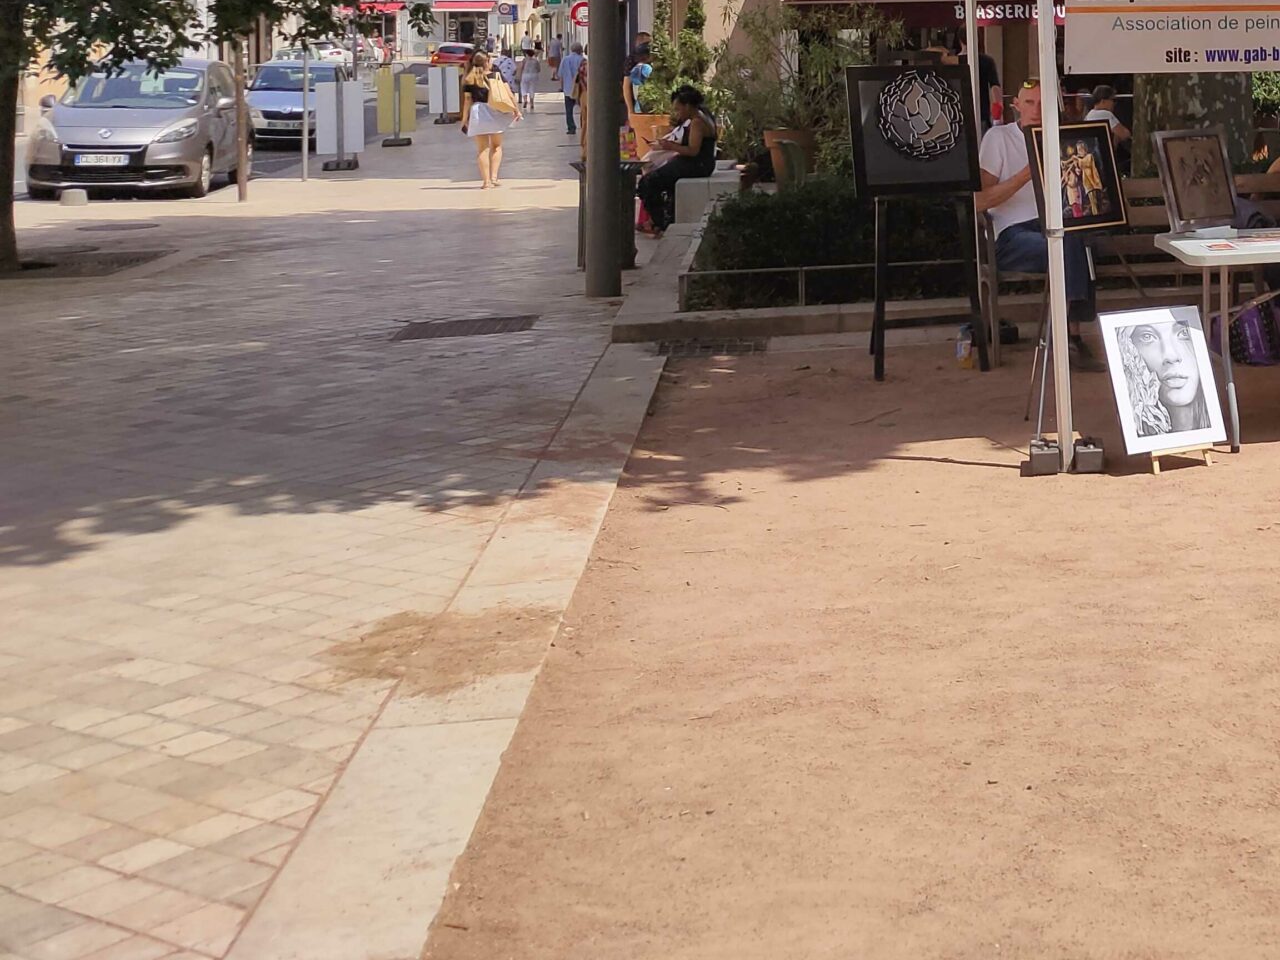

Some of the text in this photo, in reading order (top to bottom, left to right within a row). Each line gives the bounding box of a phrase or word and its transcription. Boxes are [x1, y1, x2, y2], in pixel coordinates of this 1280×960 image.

[954, 4, 1039, 19] BASSERIE
[1112, 15, 1211, 31] Association
[1217, 15, 1238, 30] de
